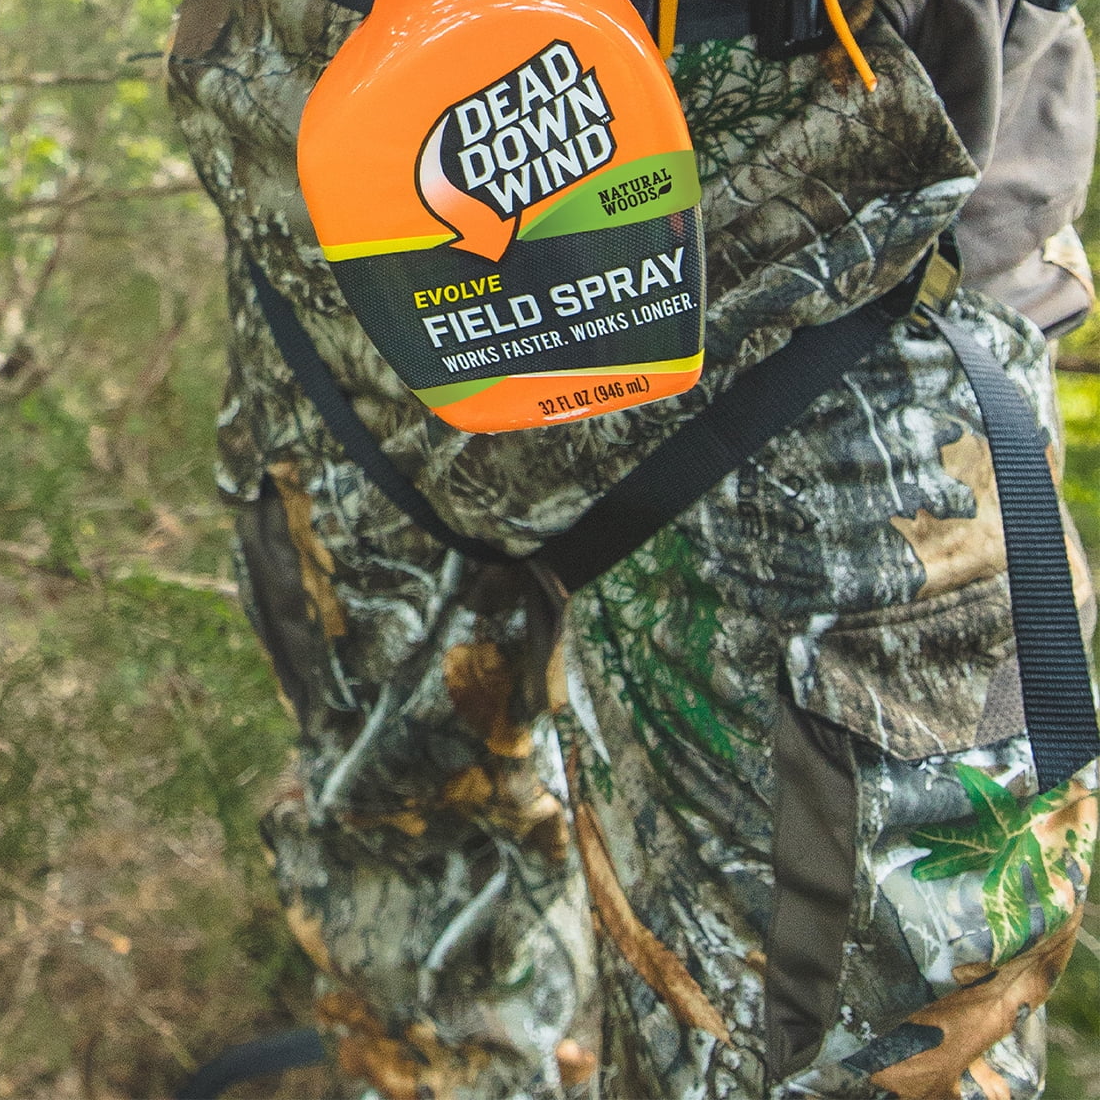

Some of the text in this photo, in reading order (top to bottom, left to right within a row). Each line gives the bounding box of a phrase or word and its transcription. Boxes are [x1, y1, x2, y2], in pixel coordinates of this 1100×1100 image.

[454, 43, 579, 147] DEAD
[457, 74, 608, 191] DOWN
[485, 123, 613, 214] WIND
[597, 167, 672, 204] NATURAL
[602, 186, 659, 216] WOODS
[413, 274, 502, 309] EVOLVE
[422, 246, 685, 348] FIELD SPRAY
[441, 292, 698, 373] WORKS FASTER. WORKS LONGER.
[538, 375, 650, 416] 32 FL OZ (946 mL)
